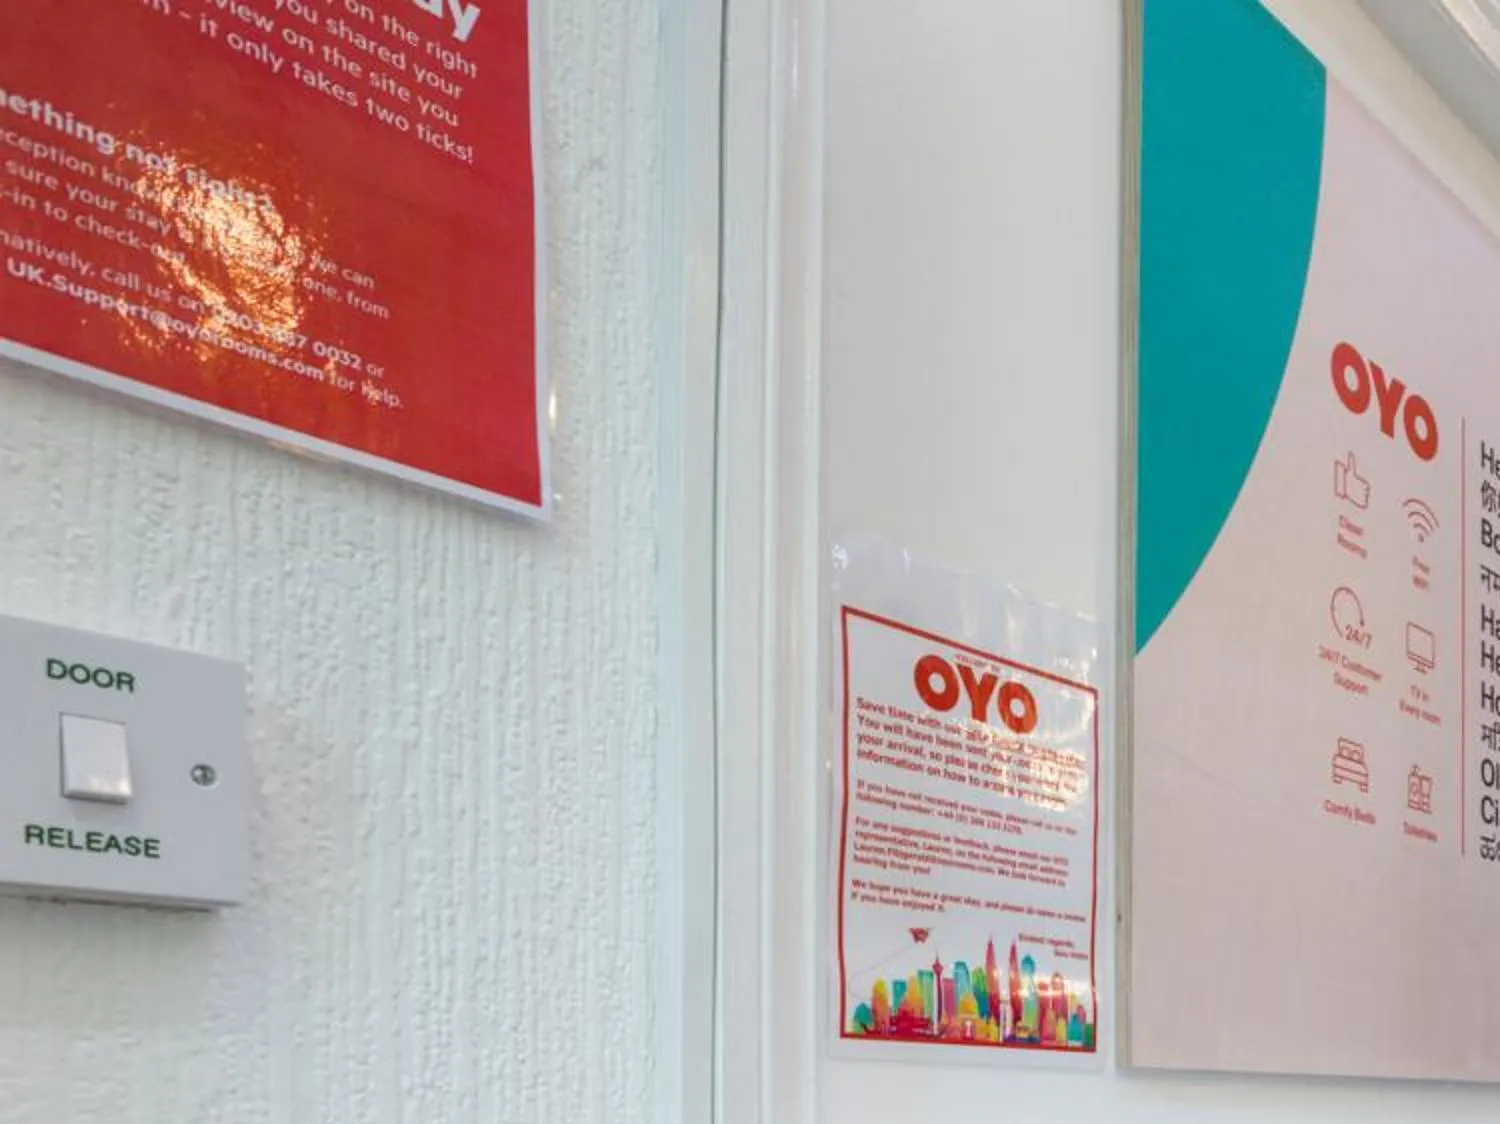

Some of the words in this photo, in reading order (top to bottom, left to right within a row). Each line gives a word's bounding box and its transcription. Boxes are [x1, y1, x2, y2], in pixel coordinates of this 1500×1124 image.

[327, 17, 406, 70] shared
[413, 64, 464, 100] your
[382, 13, 420, 47] the
[427, 39, 479, 79] right
[200, 12, 218, 38] it
[227, 32, 284, 73] only
[293, 61, 358, 108] takes
[366, 98, 410, 132] two
[417, 123, 475, 164] ticks!
[282, 28, 315, 56] on
[323, 45, 362, 78] the
[370, 71, 410, 104] site
[418, 98, 459, 128] you
[5, 160, 59, 191] sure
[66, 181, 119, 214] your
[125, 203, 171, 236] stay
[43, 201, 68, 222] to
[342, 268, 375, 291] can
[101, 267, 140, 291] call
[148, 283, 172, 302] us
[313, 341, 363, 370] 0032
[366, 363, 385, 378] or
[347, 291, 390, 320] from
[1331, 341, 1438, 461] OYO
[46, 658, 136, 693] DOOR
[914, 655, 1037, 734] OYO
[856, 713, 880, 730] You
[905, 726, 933, 744] have
[856, 731, 882, 748] your
[929, 749, 942, 763] so
[927, 764, 940, 777] on
[24, 824, 161, 859] RELEASE
